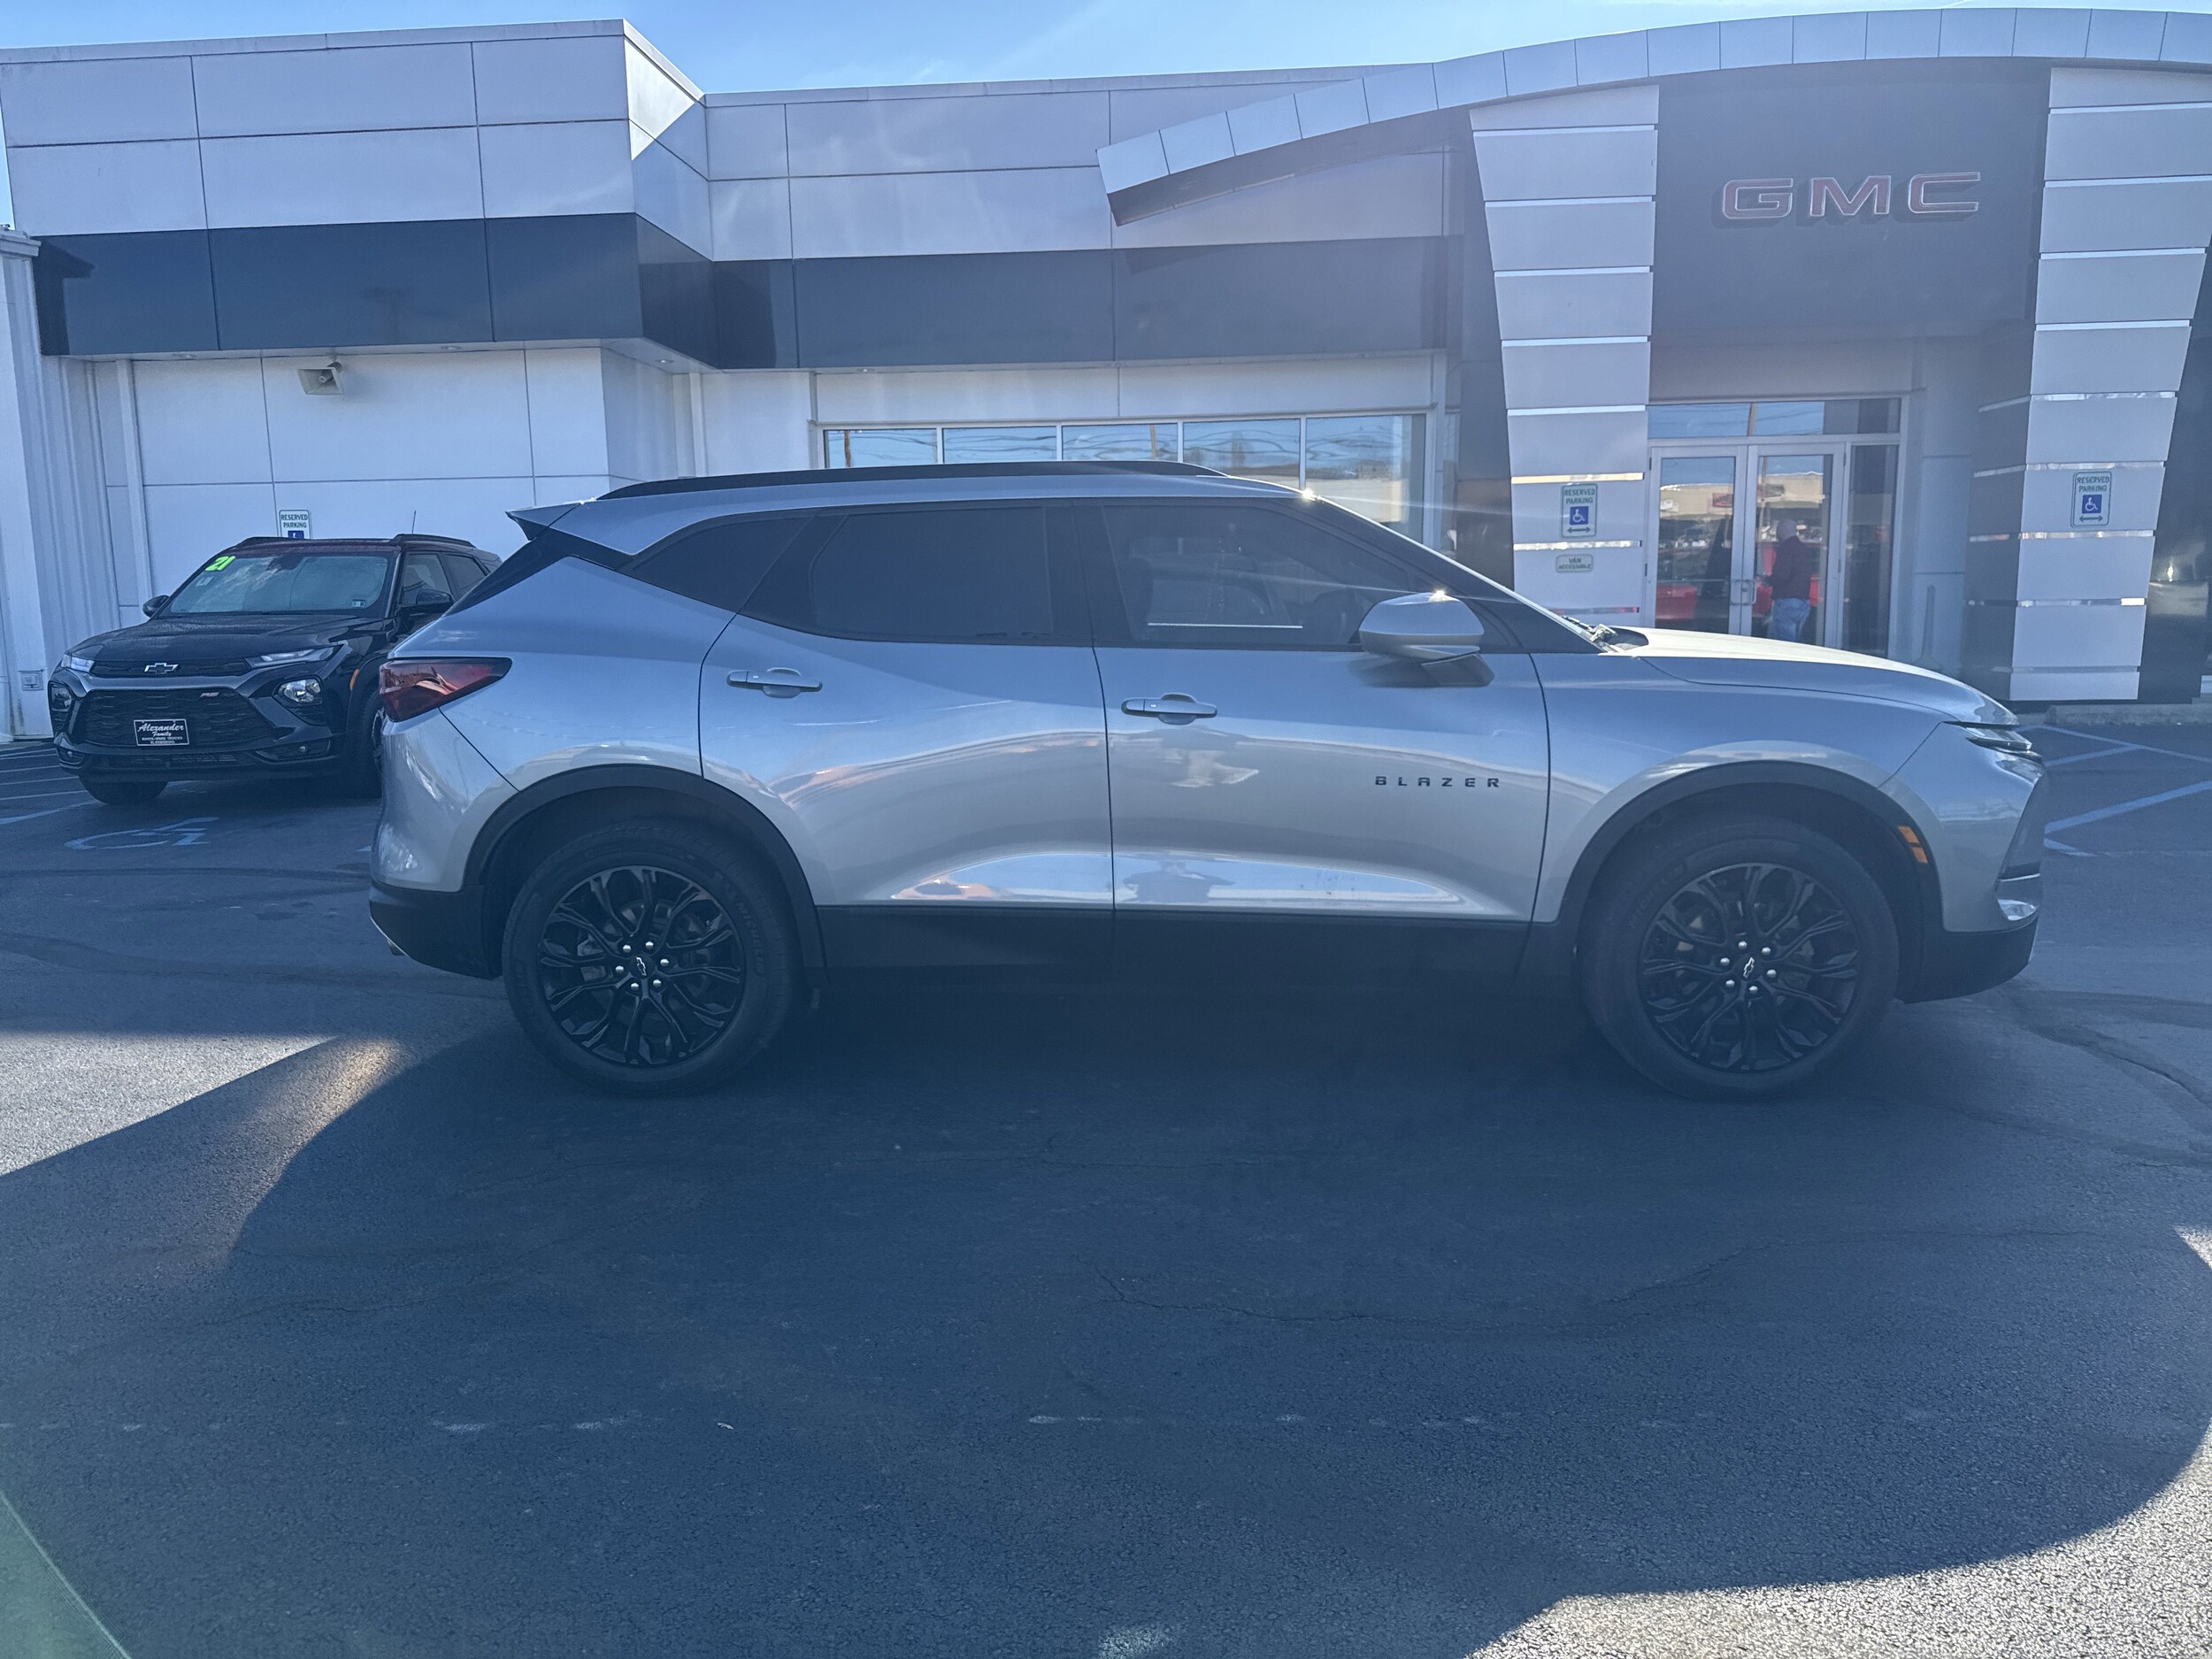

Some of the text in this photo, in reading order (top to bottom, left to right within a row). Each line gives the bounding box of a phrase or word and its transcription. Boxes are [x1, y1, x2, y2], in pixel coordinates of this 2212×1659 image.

[1722, 172, 1981, 219] GMC
[204, 556, 236, 572] 21
[137, 723, 184, 733] Alexander
[1375, 776, 1499, 787] BLAZER
